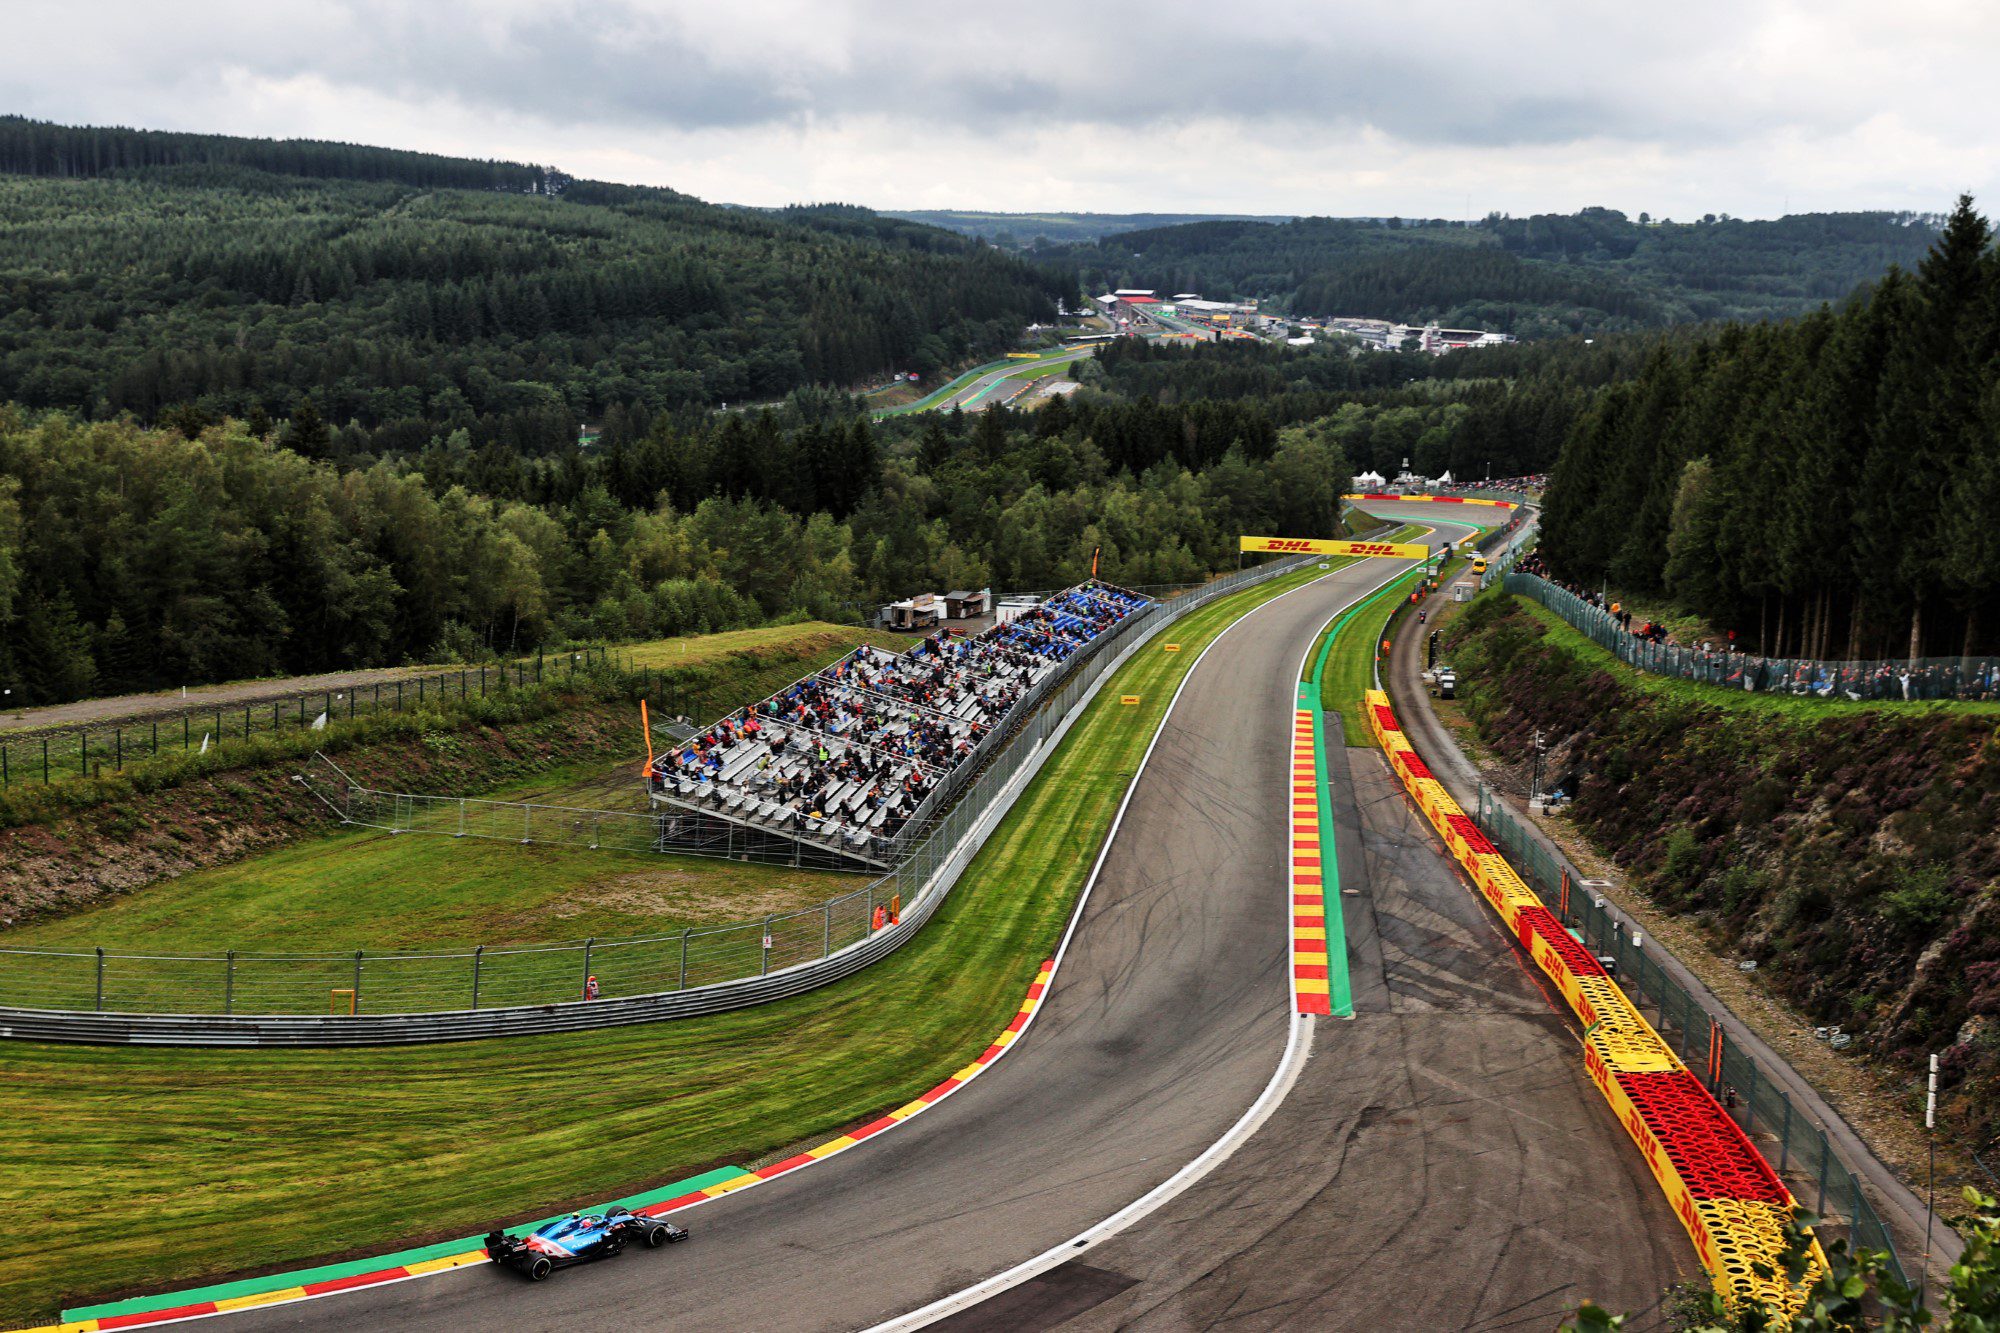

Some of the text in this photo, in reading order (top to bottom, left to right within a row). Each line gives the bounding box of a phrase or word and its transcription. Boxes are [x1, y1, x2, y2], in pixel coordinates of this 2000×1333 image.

[1267, 540, 1312, 552] DHL
[1349, 543, 1395, 556] DHL
[1486, 878, 1505, 911] DHL
[1543, 948, 1567, 990] DHL
[1585, 1043, 1610, 1094] DHL
[1630, 1108, 1659, 1170] DHL
[1681, 1188, 1711, 1264] DHL
